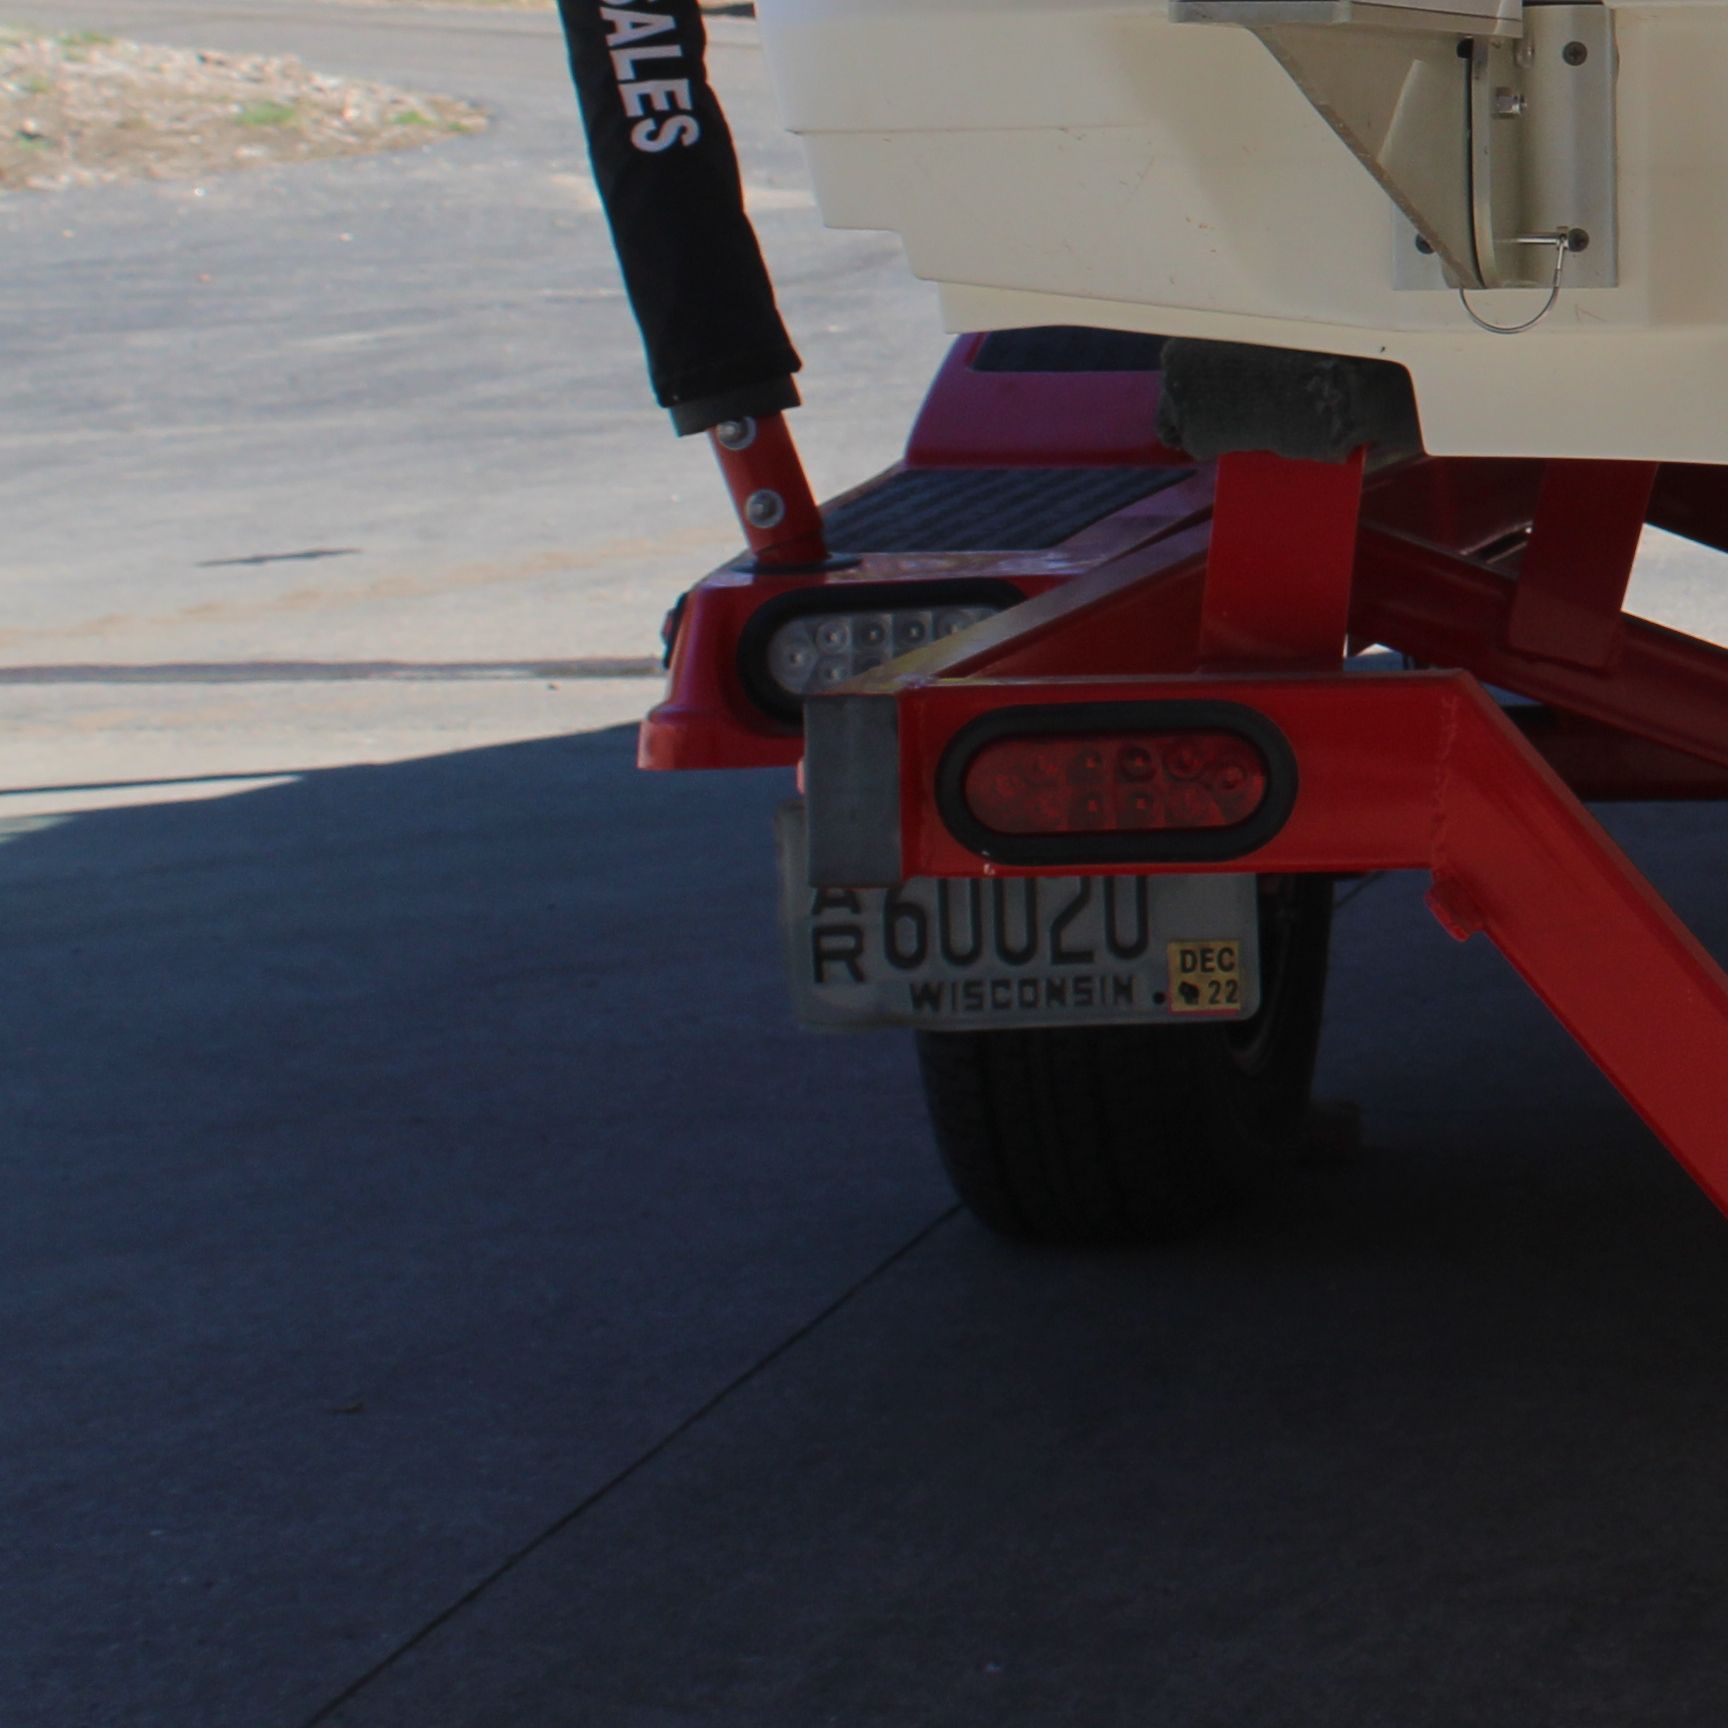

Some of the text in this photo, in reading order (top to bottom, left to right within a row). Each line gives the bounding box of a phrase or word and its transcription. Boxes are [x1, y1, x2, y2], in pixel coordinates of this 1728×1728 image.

[1179, 946, 1236, 974] DEC
[909, 976, 1135, 1014] WISCONSIN
[1206, 979, 1240, 1006] 22
